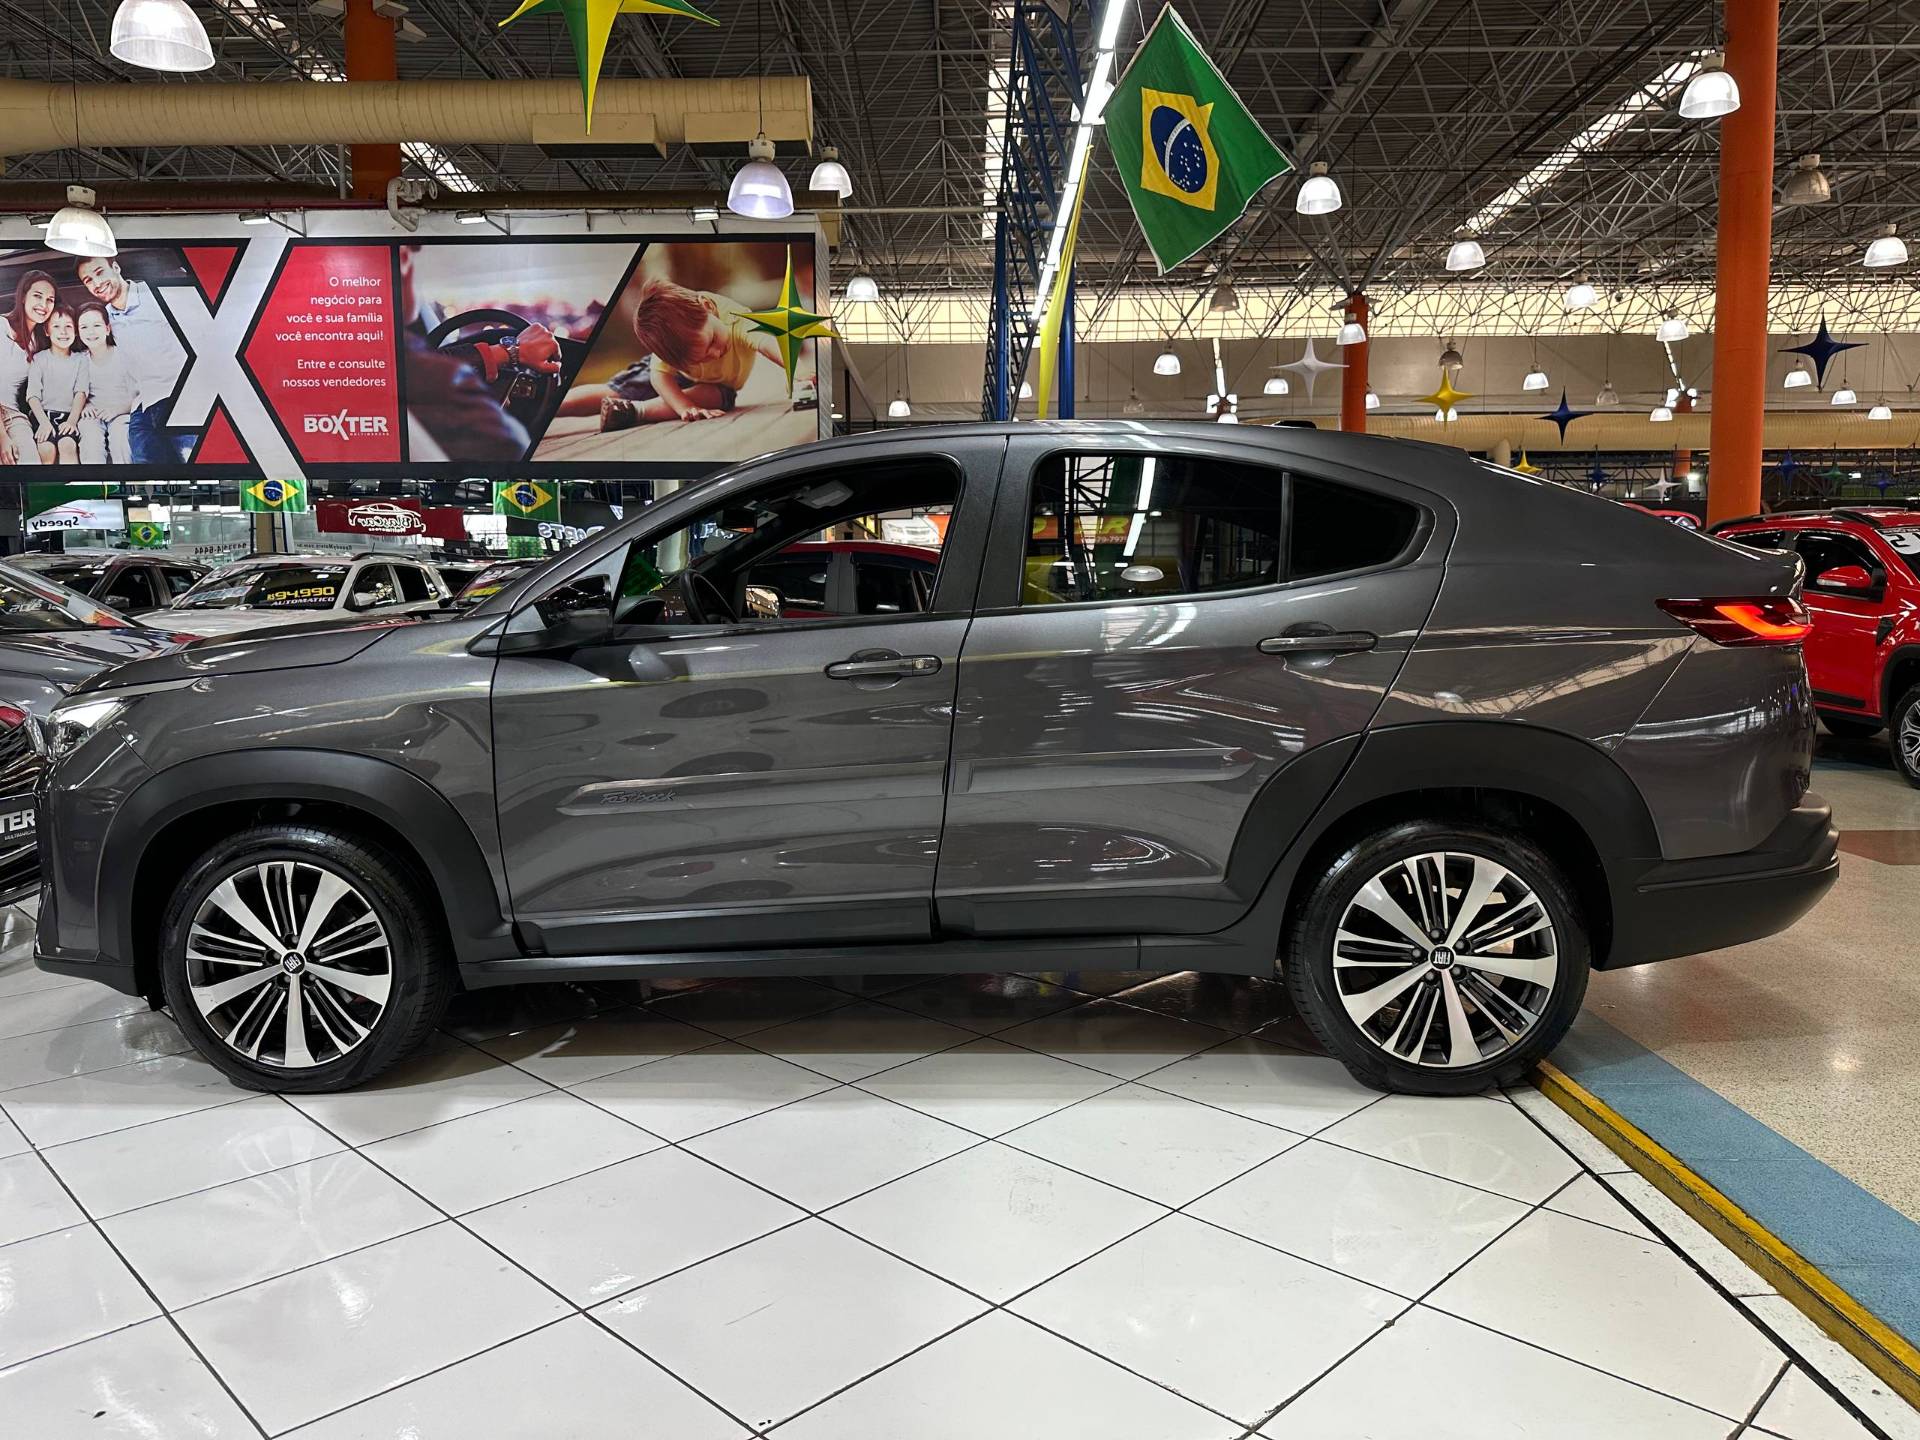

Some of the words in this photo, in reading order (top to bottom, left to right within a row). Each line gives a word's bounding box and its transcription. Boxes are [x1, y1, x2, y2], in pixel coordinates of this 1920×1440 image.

[329, 277, 339, 287] O
[342, 276, 381, 287] melhor
[310, 293, 356, 307] negócio
[358, 295, 382, 307] para
[286, 313, 313, 323] você
[315, 315, 323, 323] e
[325, 315, 344, 323] sua
[346, 312, 383, 323] família
[275, 331, 302, 341] você
[304, 331, 354, 341] encontra
[356, 330, 384, 343] aqui!
[297, 359, 326, 369] Entre
[328, 361, 336, 369] e
[338, 359, 386, 369] consulte
[282, 378, 320, 387] nossos
[322, 376, 386, 387] vendedores
[304, 408, 389, 441] BOXTER
[1433, 951, 1451, 965] FIAT
